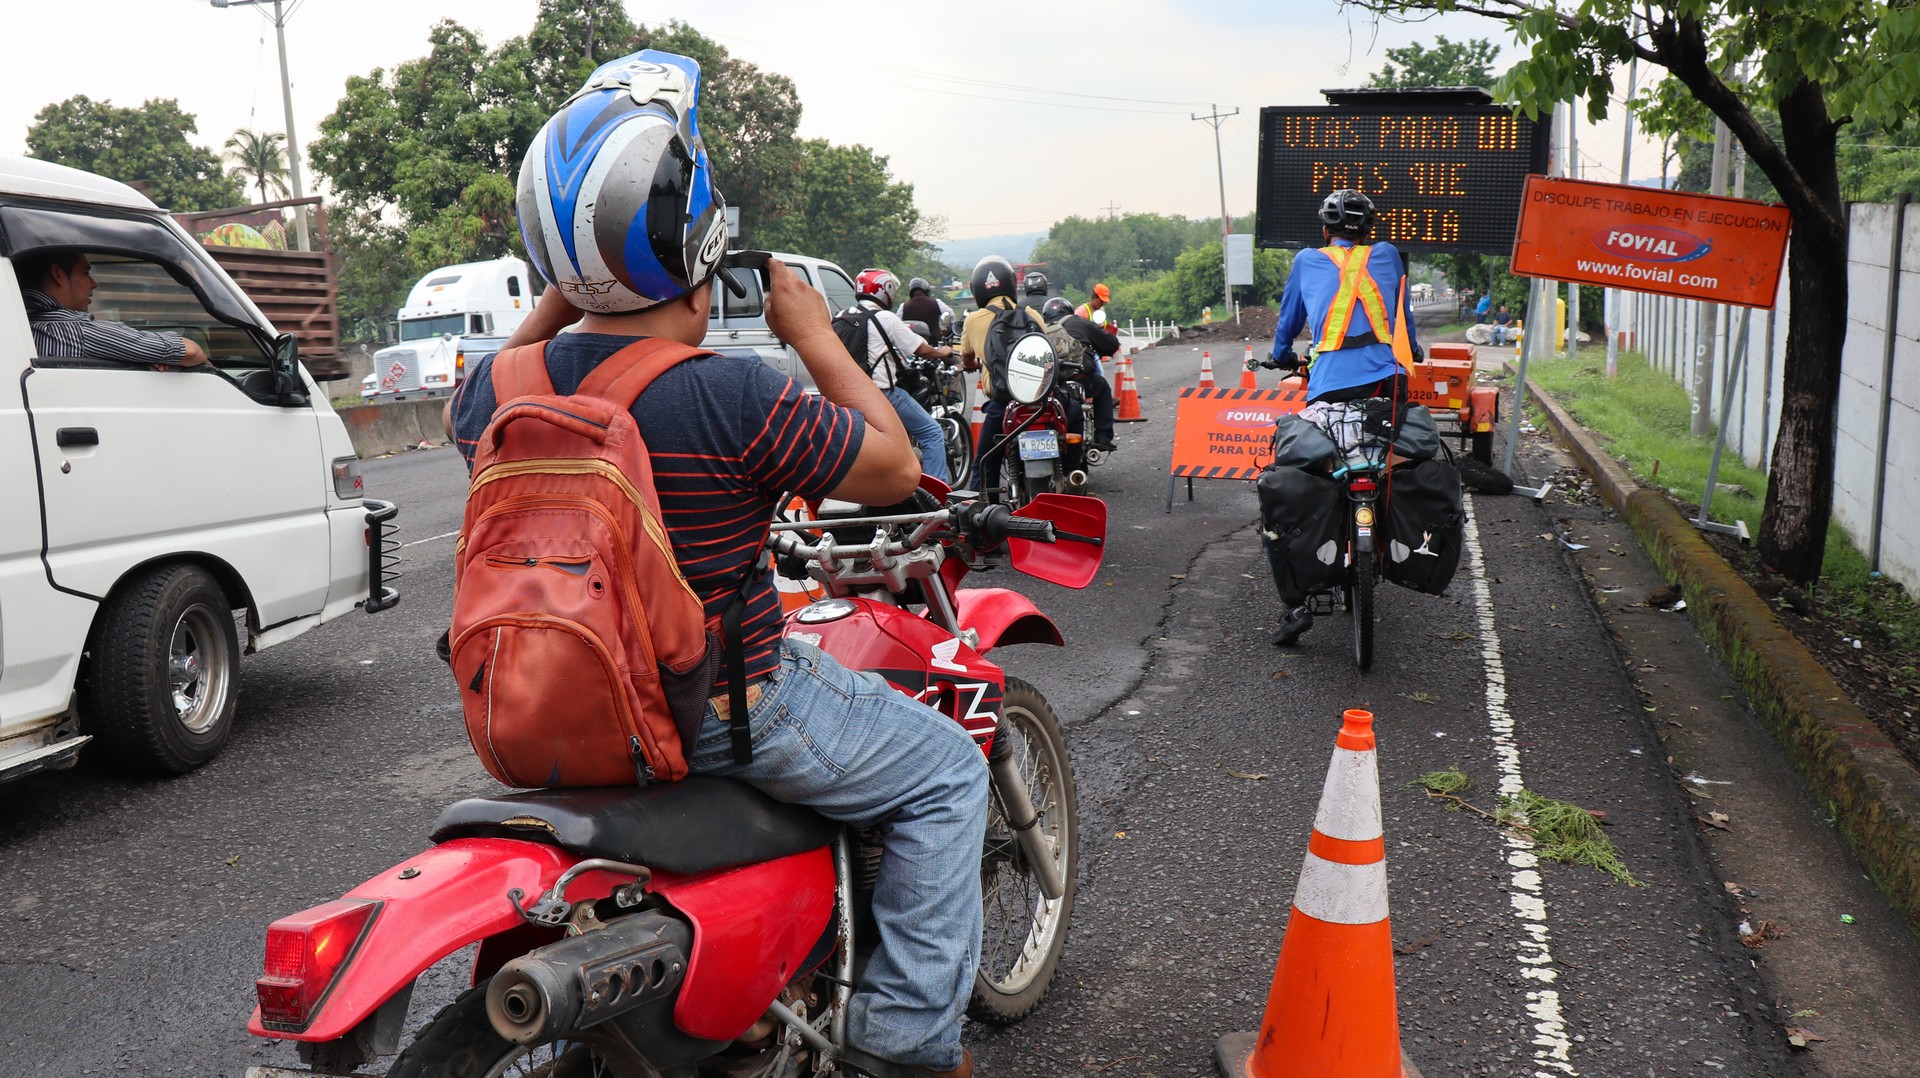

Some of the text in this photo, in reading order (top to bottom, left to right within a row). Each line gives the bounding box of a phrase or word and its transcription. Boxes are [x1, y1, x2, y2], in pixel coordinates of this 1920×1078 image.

[1379, 116, 1458, 149] PARA
[1311, 161, 1389, 194] PAIS
[1370, 207, 1459, 242] MBIA
[1533, 190, 1782, 232] DISCULPE TRABAJO EN EJECUCIÓN
[1606, 230, 1679, 256] FOVIAL
[560, 279, 617, 295] FLY
[1577, 259, 1719, 289] www.fovial.com
[1226, 411, 1273, 422] FOVIAL
[1209, 445, 1244, 455] PARA
